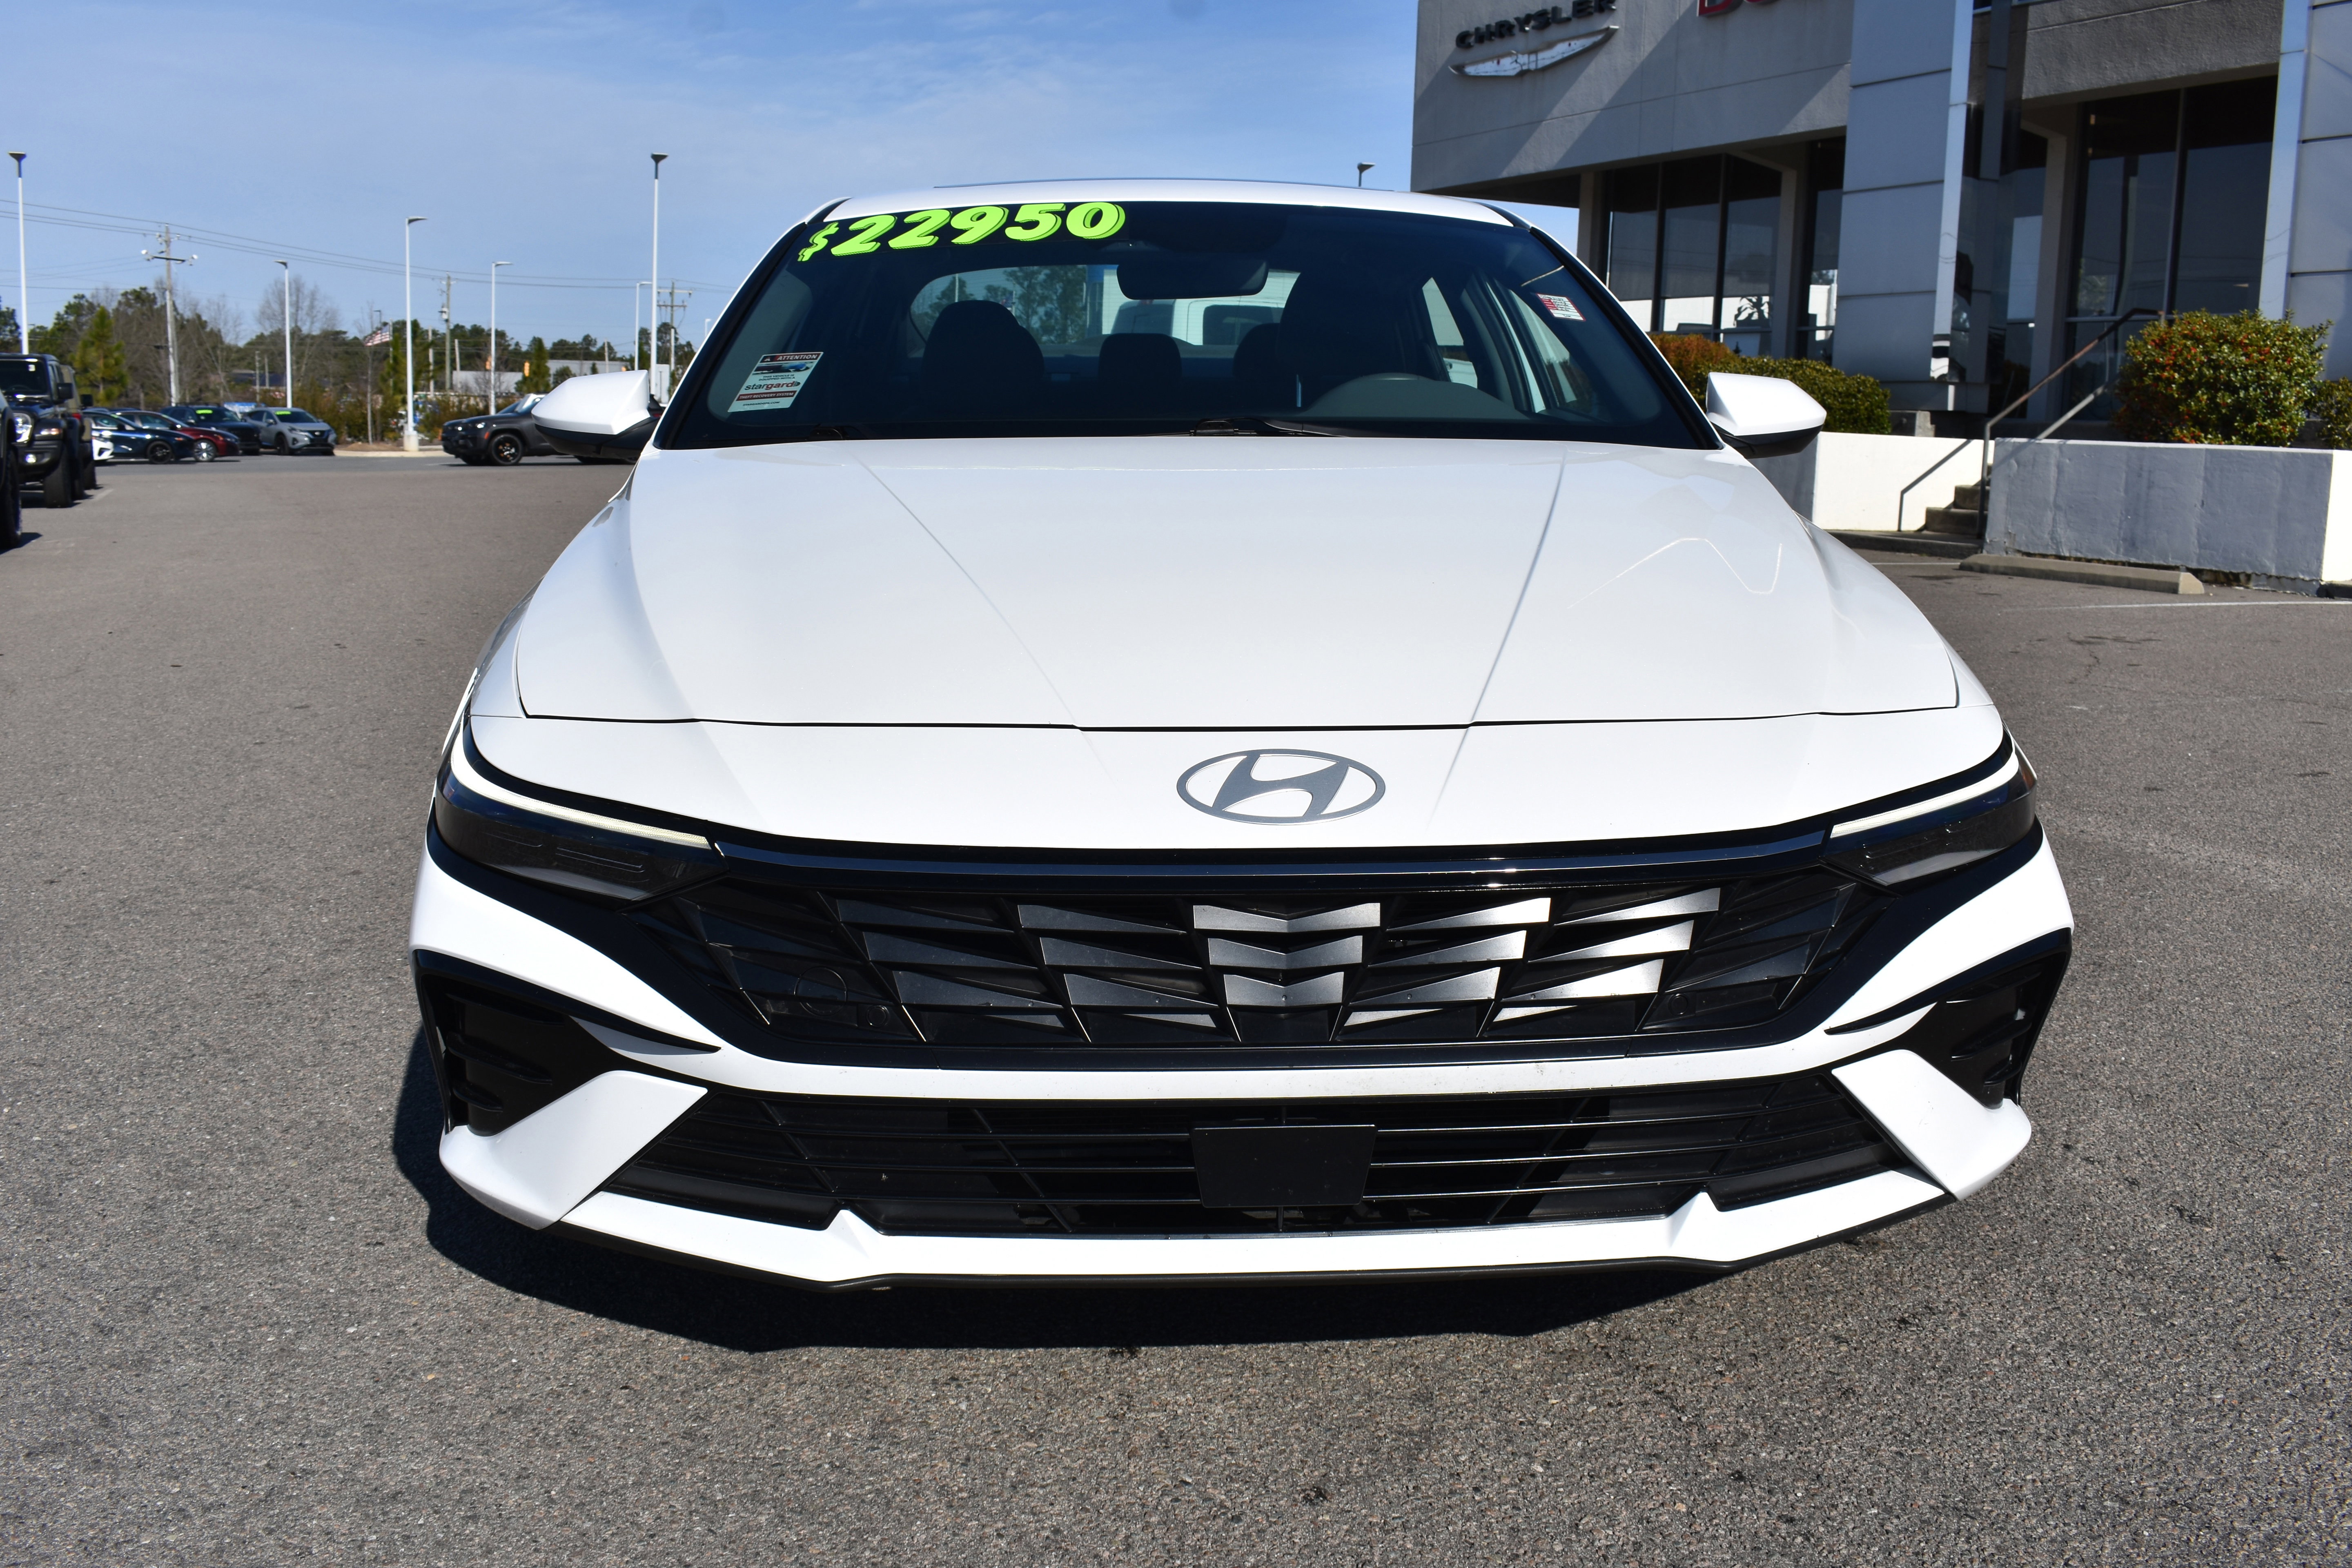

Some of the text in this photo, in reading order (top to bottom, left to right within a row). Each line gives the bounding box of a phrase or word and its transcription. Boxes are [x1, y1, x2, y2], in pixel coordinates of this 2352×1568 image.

[1456, 0, 1617, 48] CHRYSLER
[797, 202, 1125, 262] $22950
[744, 381, 795, 390] stargard
